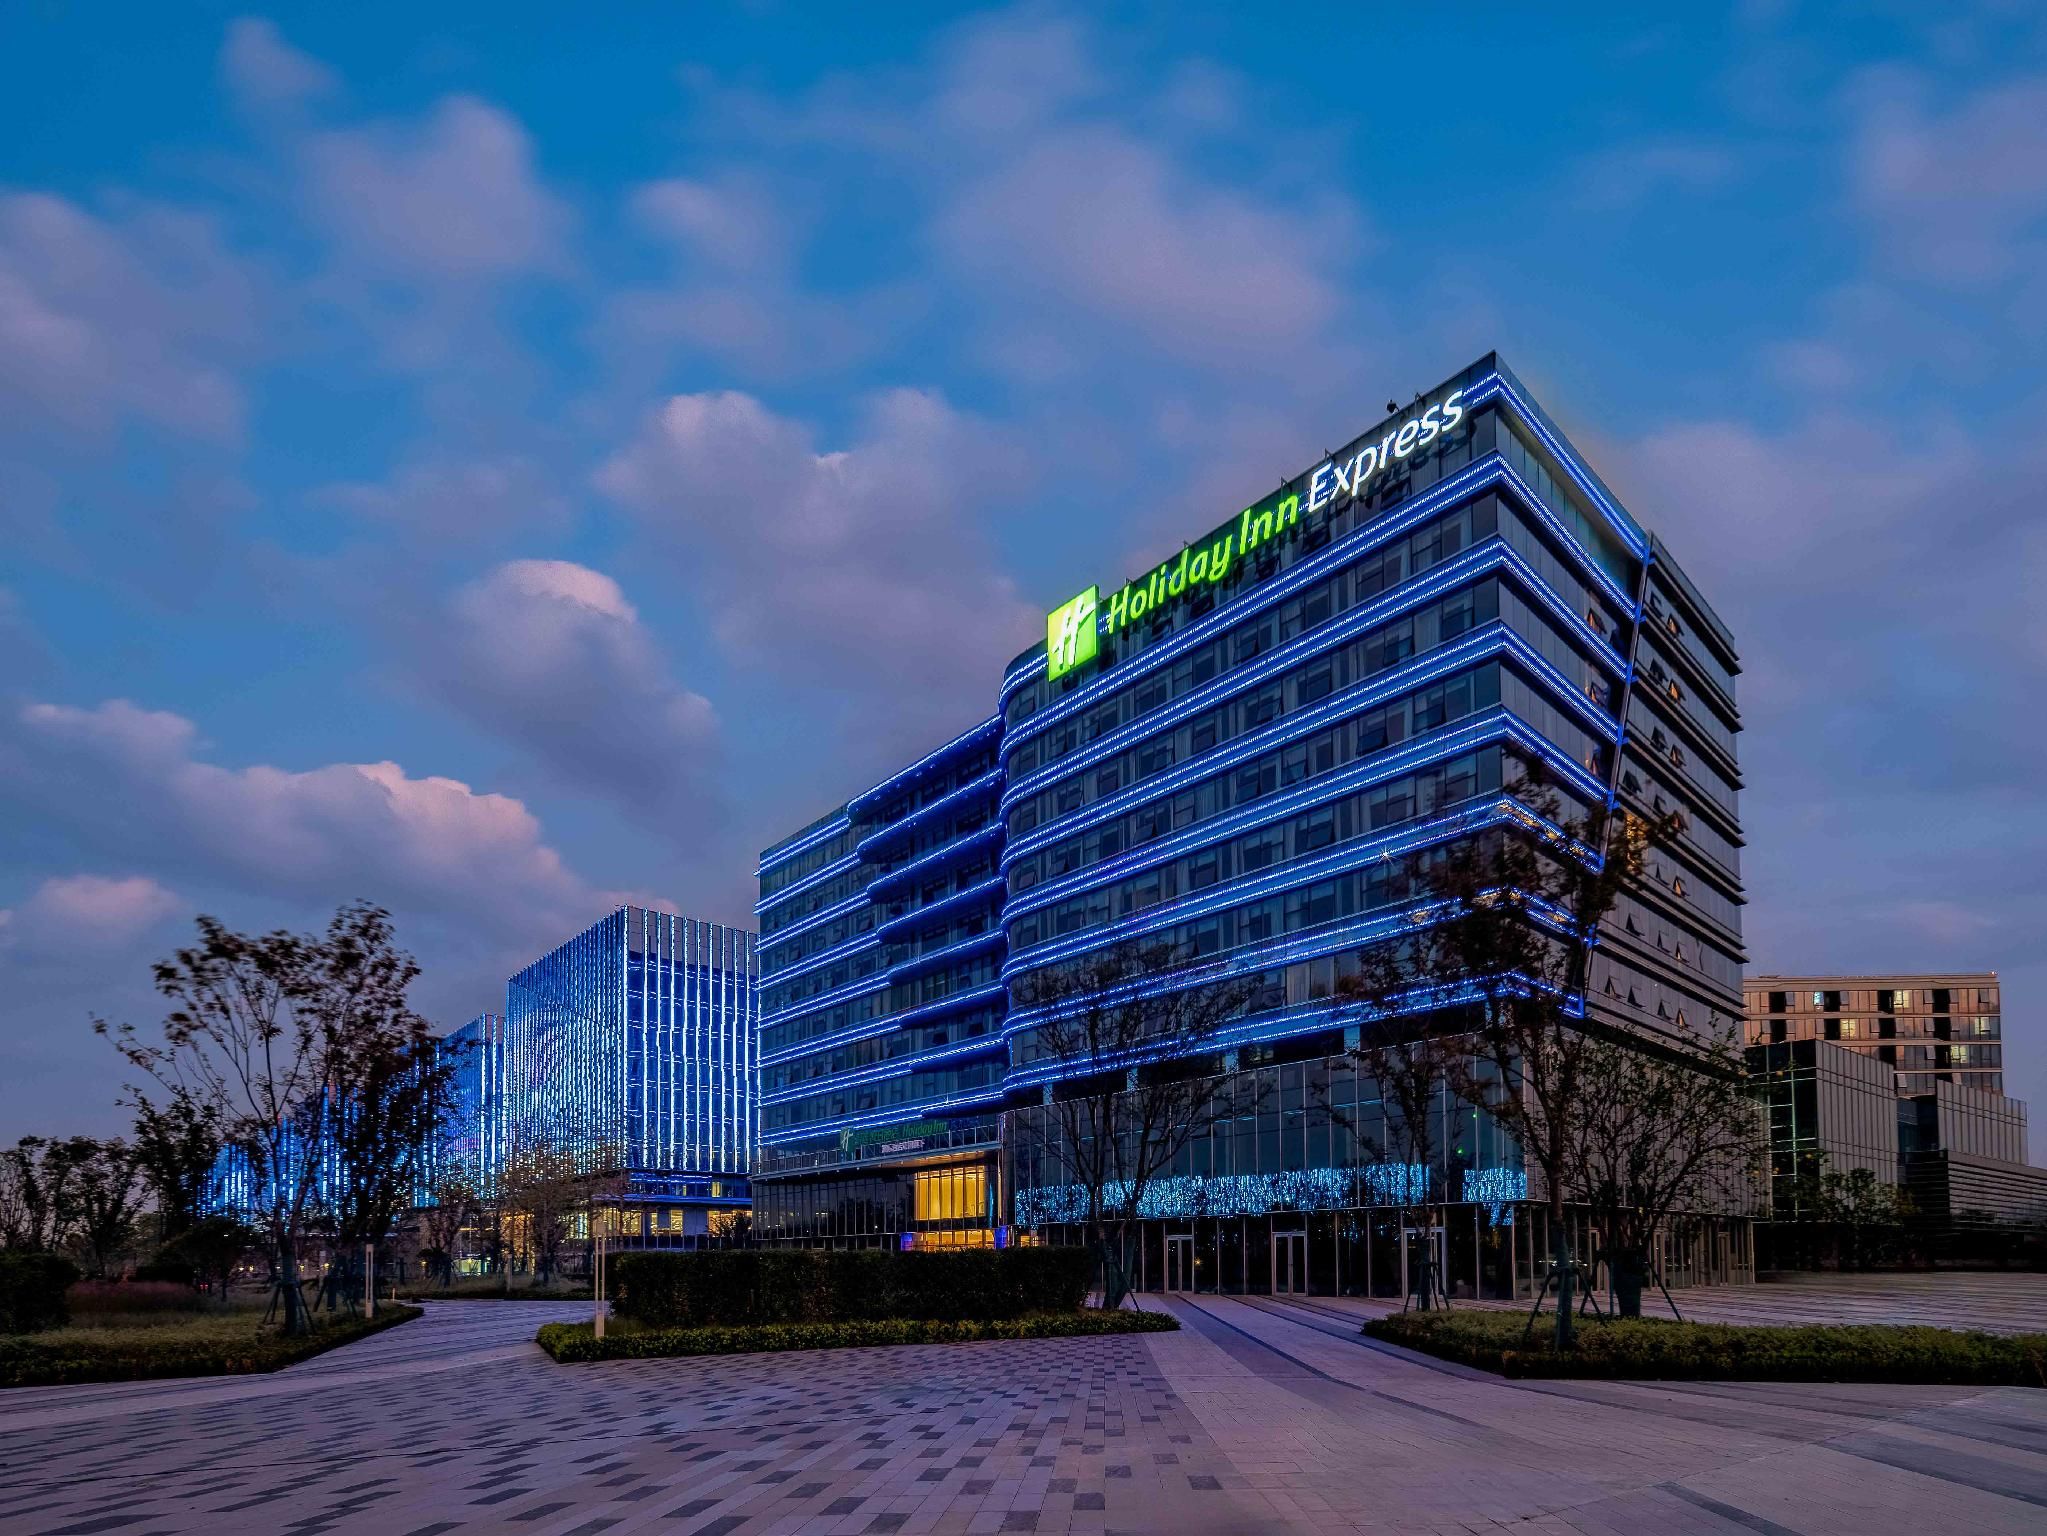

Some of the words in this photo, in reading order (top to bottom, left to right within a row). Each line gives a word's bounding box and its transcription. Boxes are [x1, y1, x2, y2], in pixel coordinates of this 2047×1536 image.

[1106, 534, 1233, 634] Holiday
[1239, 495, 1299, 555] Inn
[1308, 390, 1463, 513] Express
